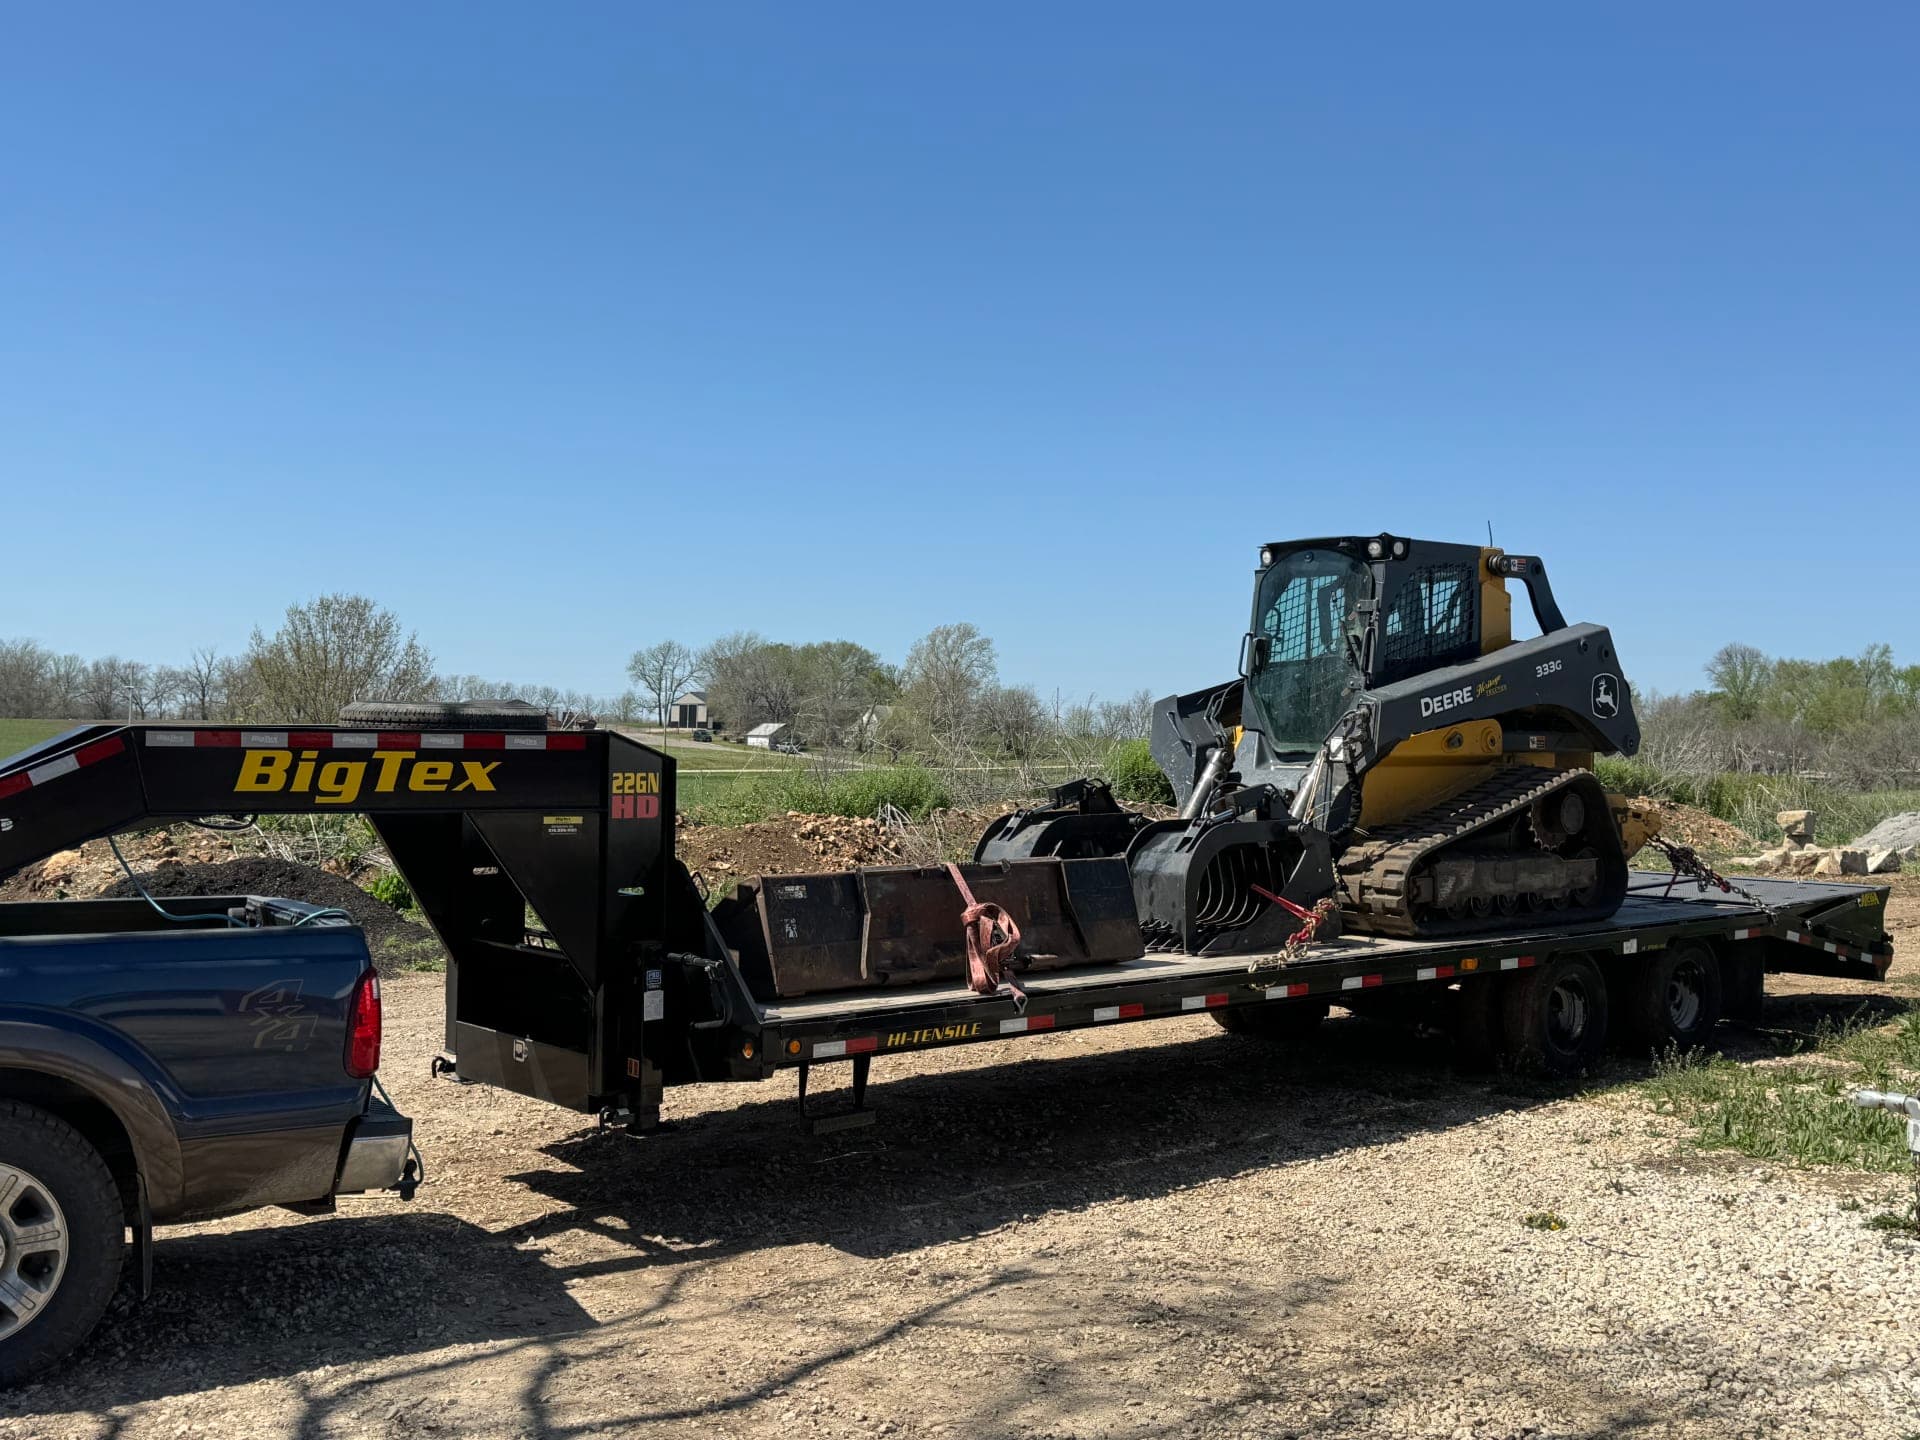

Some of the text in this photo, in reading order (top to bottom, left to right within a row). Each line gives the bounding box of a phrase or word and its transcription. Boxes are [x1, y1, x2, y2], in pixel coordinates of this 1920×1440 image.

[1535, 660, 1562, 678] 333G
[1420, 686, 1474, 717] DEERE
[233, 750, 502, 804] BigTex
[611, 795, 659, 819] HD
[887, 1022, 982, 1047] HI-TENSILE
